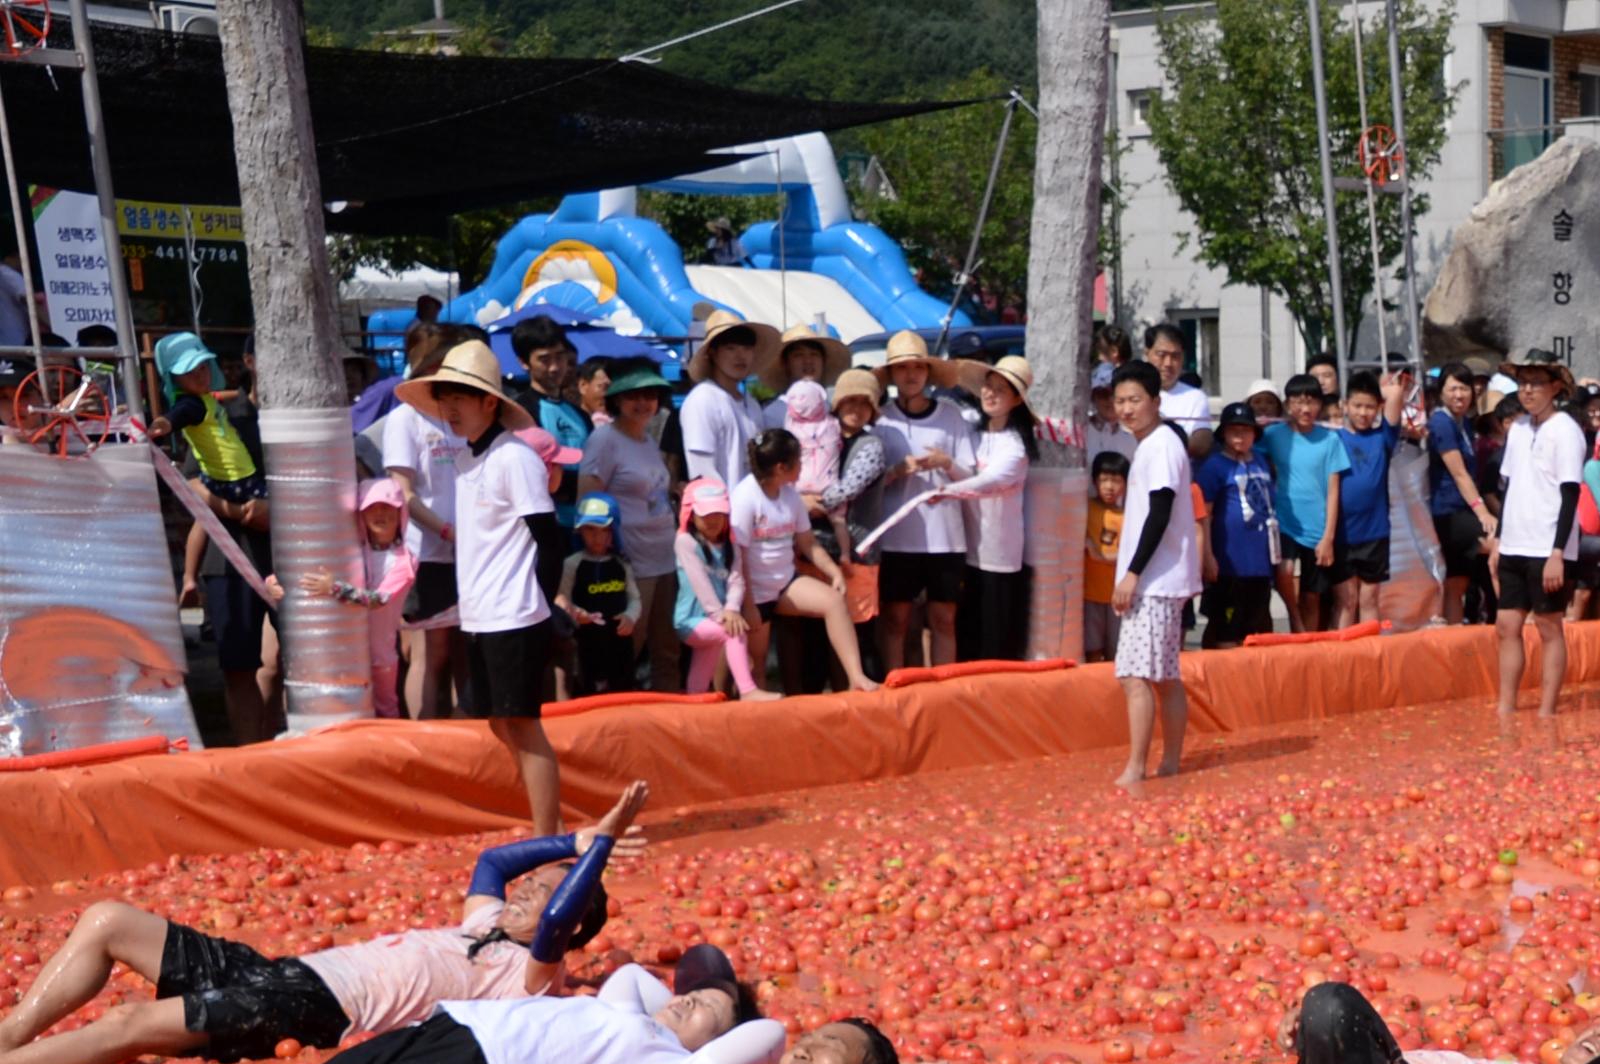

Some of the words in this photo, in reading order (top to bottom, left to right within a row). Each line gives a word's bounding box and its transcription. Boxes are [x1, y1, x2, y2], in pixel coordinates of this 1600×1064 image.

[123, 205, 182, 231] 얼음생수
[200, 211, 242, 233] 냉커피
[57, 226, 97, 243] 생맥주
[121, 245, 239, 262] 033-4417784
[50, 279, 99, 295] 아메리카노
